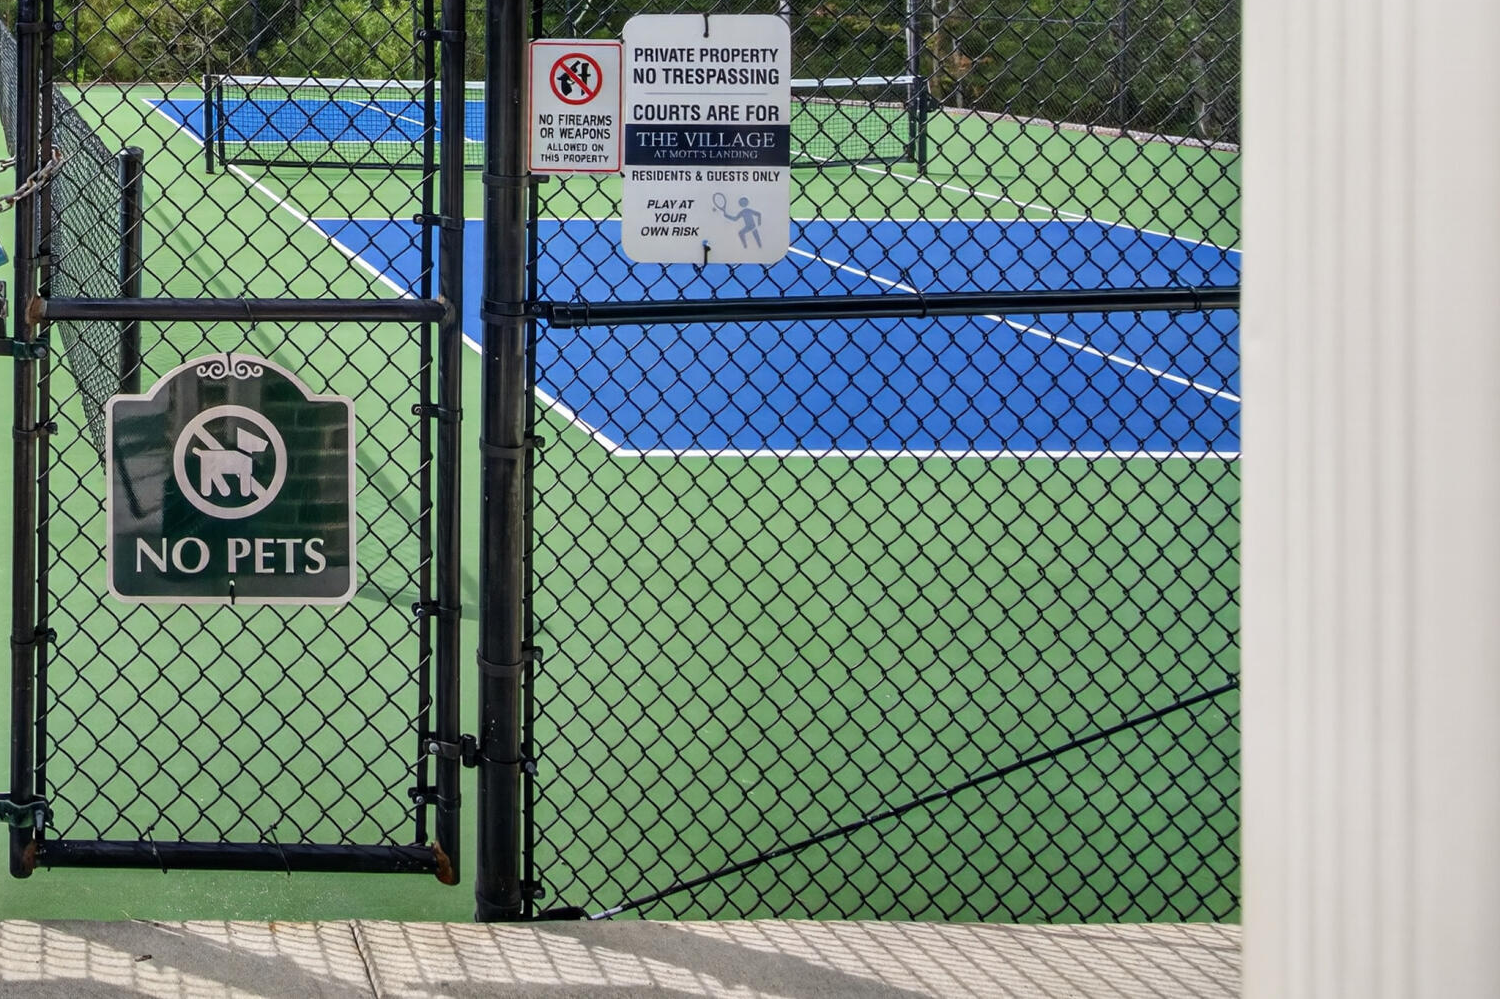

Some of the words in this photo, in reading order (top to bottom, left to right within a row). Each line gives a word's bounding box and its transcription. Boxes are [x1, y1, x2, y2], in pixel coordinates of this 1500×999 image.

[634, 48, 695, 63] PRIVATE
[699, 48, 779, 63] PROPERTY
[633, 68, 656, 84] NO
[663, 68, 779, 85] TRESPASSING
[633, 104, 701, 121] COURTS
[706, 105, 740, 121] ARE
[745, 105, 779, 121] FOR
[539, 114, 554, 125] NO
[558, 114, 612, 126] FIREARMS
[540, 127, 554, 139] OR
[559, 128, 611, 139] WEAPONS
[636, 132, 678, 147] THE
[684, 132, 776, 148] VILLAGE
[547, 143, 588, 152] ALLOWED
[591, 143, 604, 152] ON
[541, 154, 560, 162] THIS
[563, 154, 609, 163] PROPERTY
[653, 149, 666, 159] AT
[709, 150, 758, 159] LANDING
[632, 170, 692, 182] RESIDENTS
[695, 170, 703, 182] &
[706, 170, 749, 182] GUESTS
[752, 170, 780, 182] ONLY
[646, 199, 678, 210] PLAY
[678, 199, 695, 210] AT
[654, 213, 687, 223] YOUR
[640, 226, 670, 237] OWN
[671, 226, 699, 237] RISK
[135, 537, 210, 573] NO
[227, 537, 327, 574] PETS
